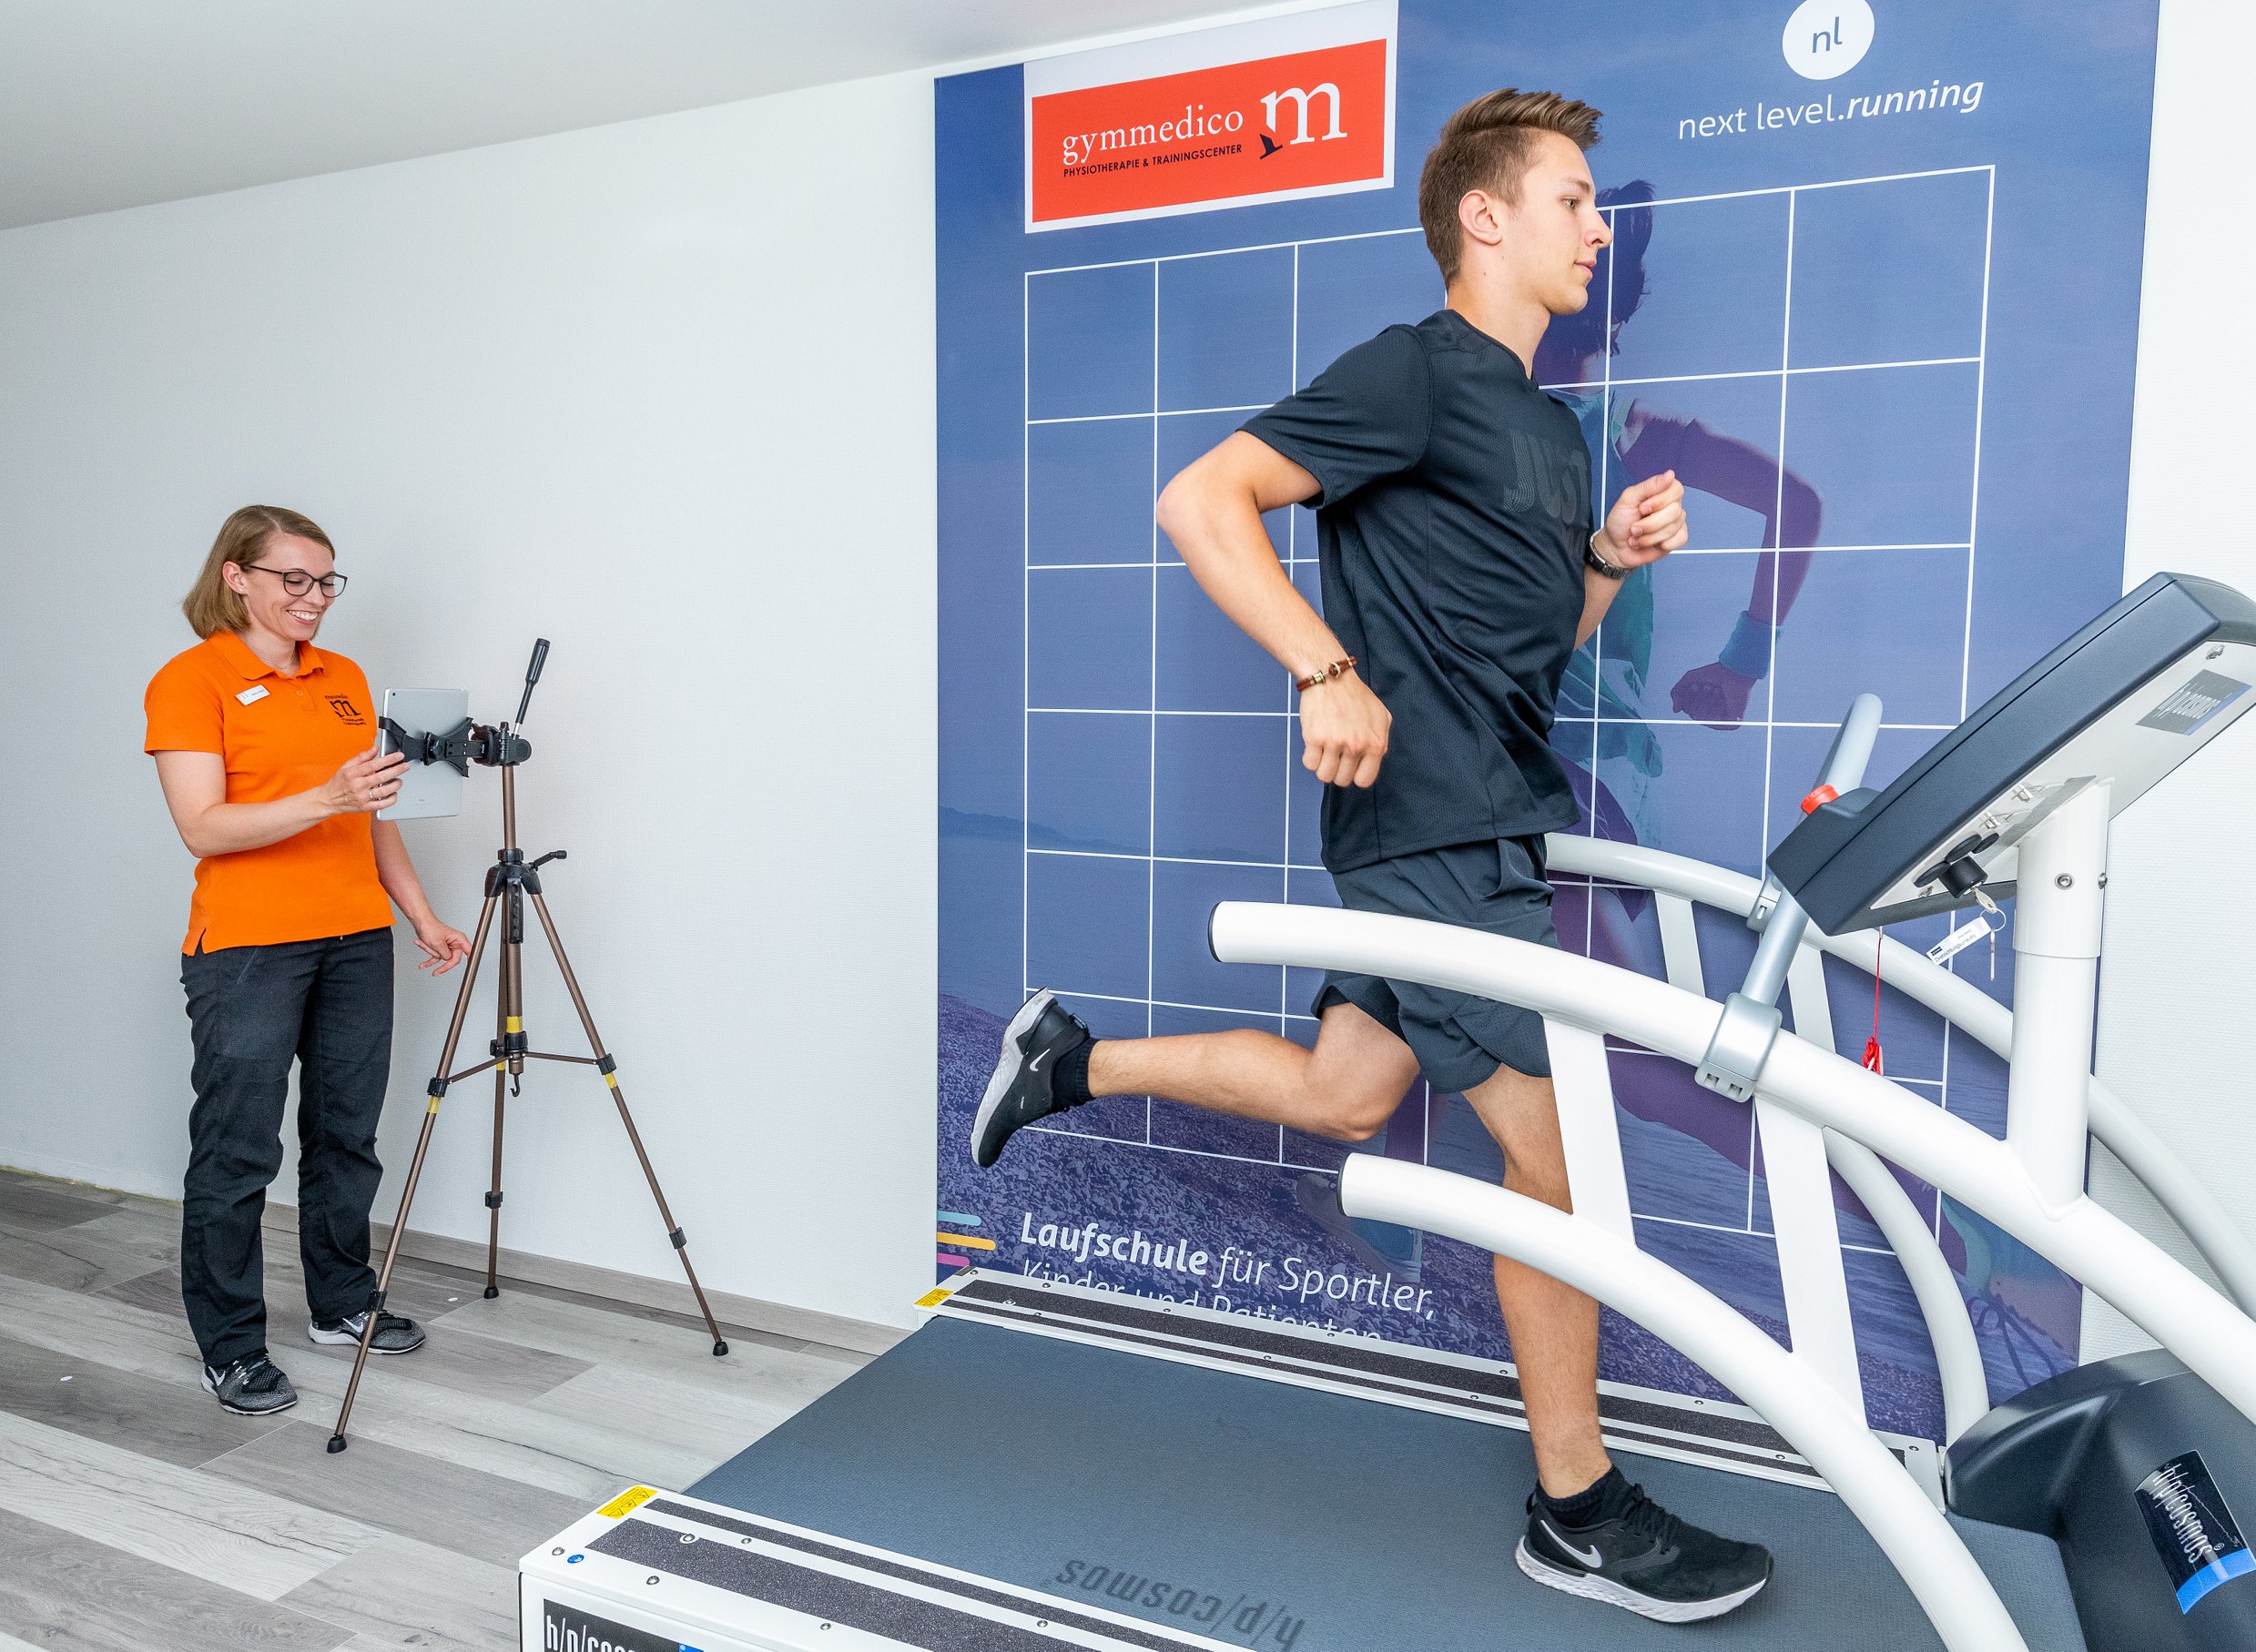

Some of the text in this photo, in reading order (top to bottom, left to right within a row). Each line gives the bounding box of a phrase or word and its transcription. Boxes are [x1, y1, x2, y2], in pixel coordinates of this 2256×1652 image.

[1811, 15, 1844, 54] nl
[1062, 104, 1244, 166] gymmedico
[1678, 79, 1985, 140] next level.running
[1062, 143, 1243, 177] PHYSIOTHERAPIE & TRAININGSCENTER
[1020, 1212, 1210, 1275] Laufschule
[1211, 1246, 1271, 1289] für
[1278, 1257, 1435, 1321] Sportler,
